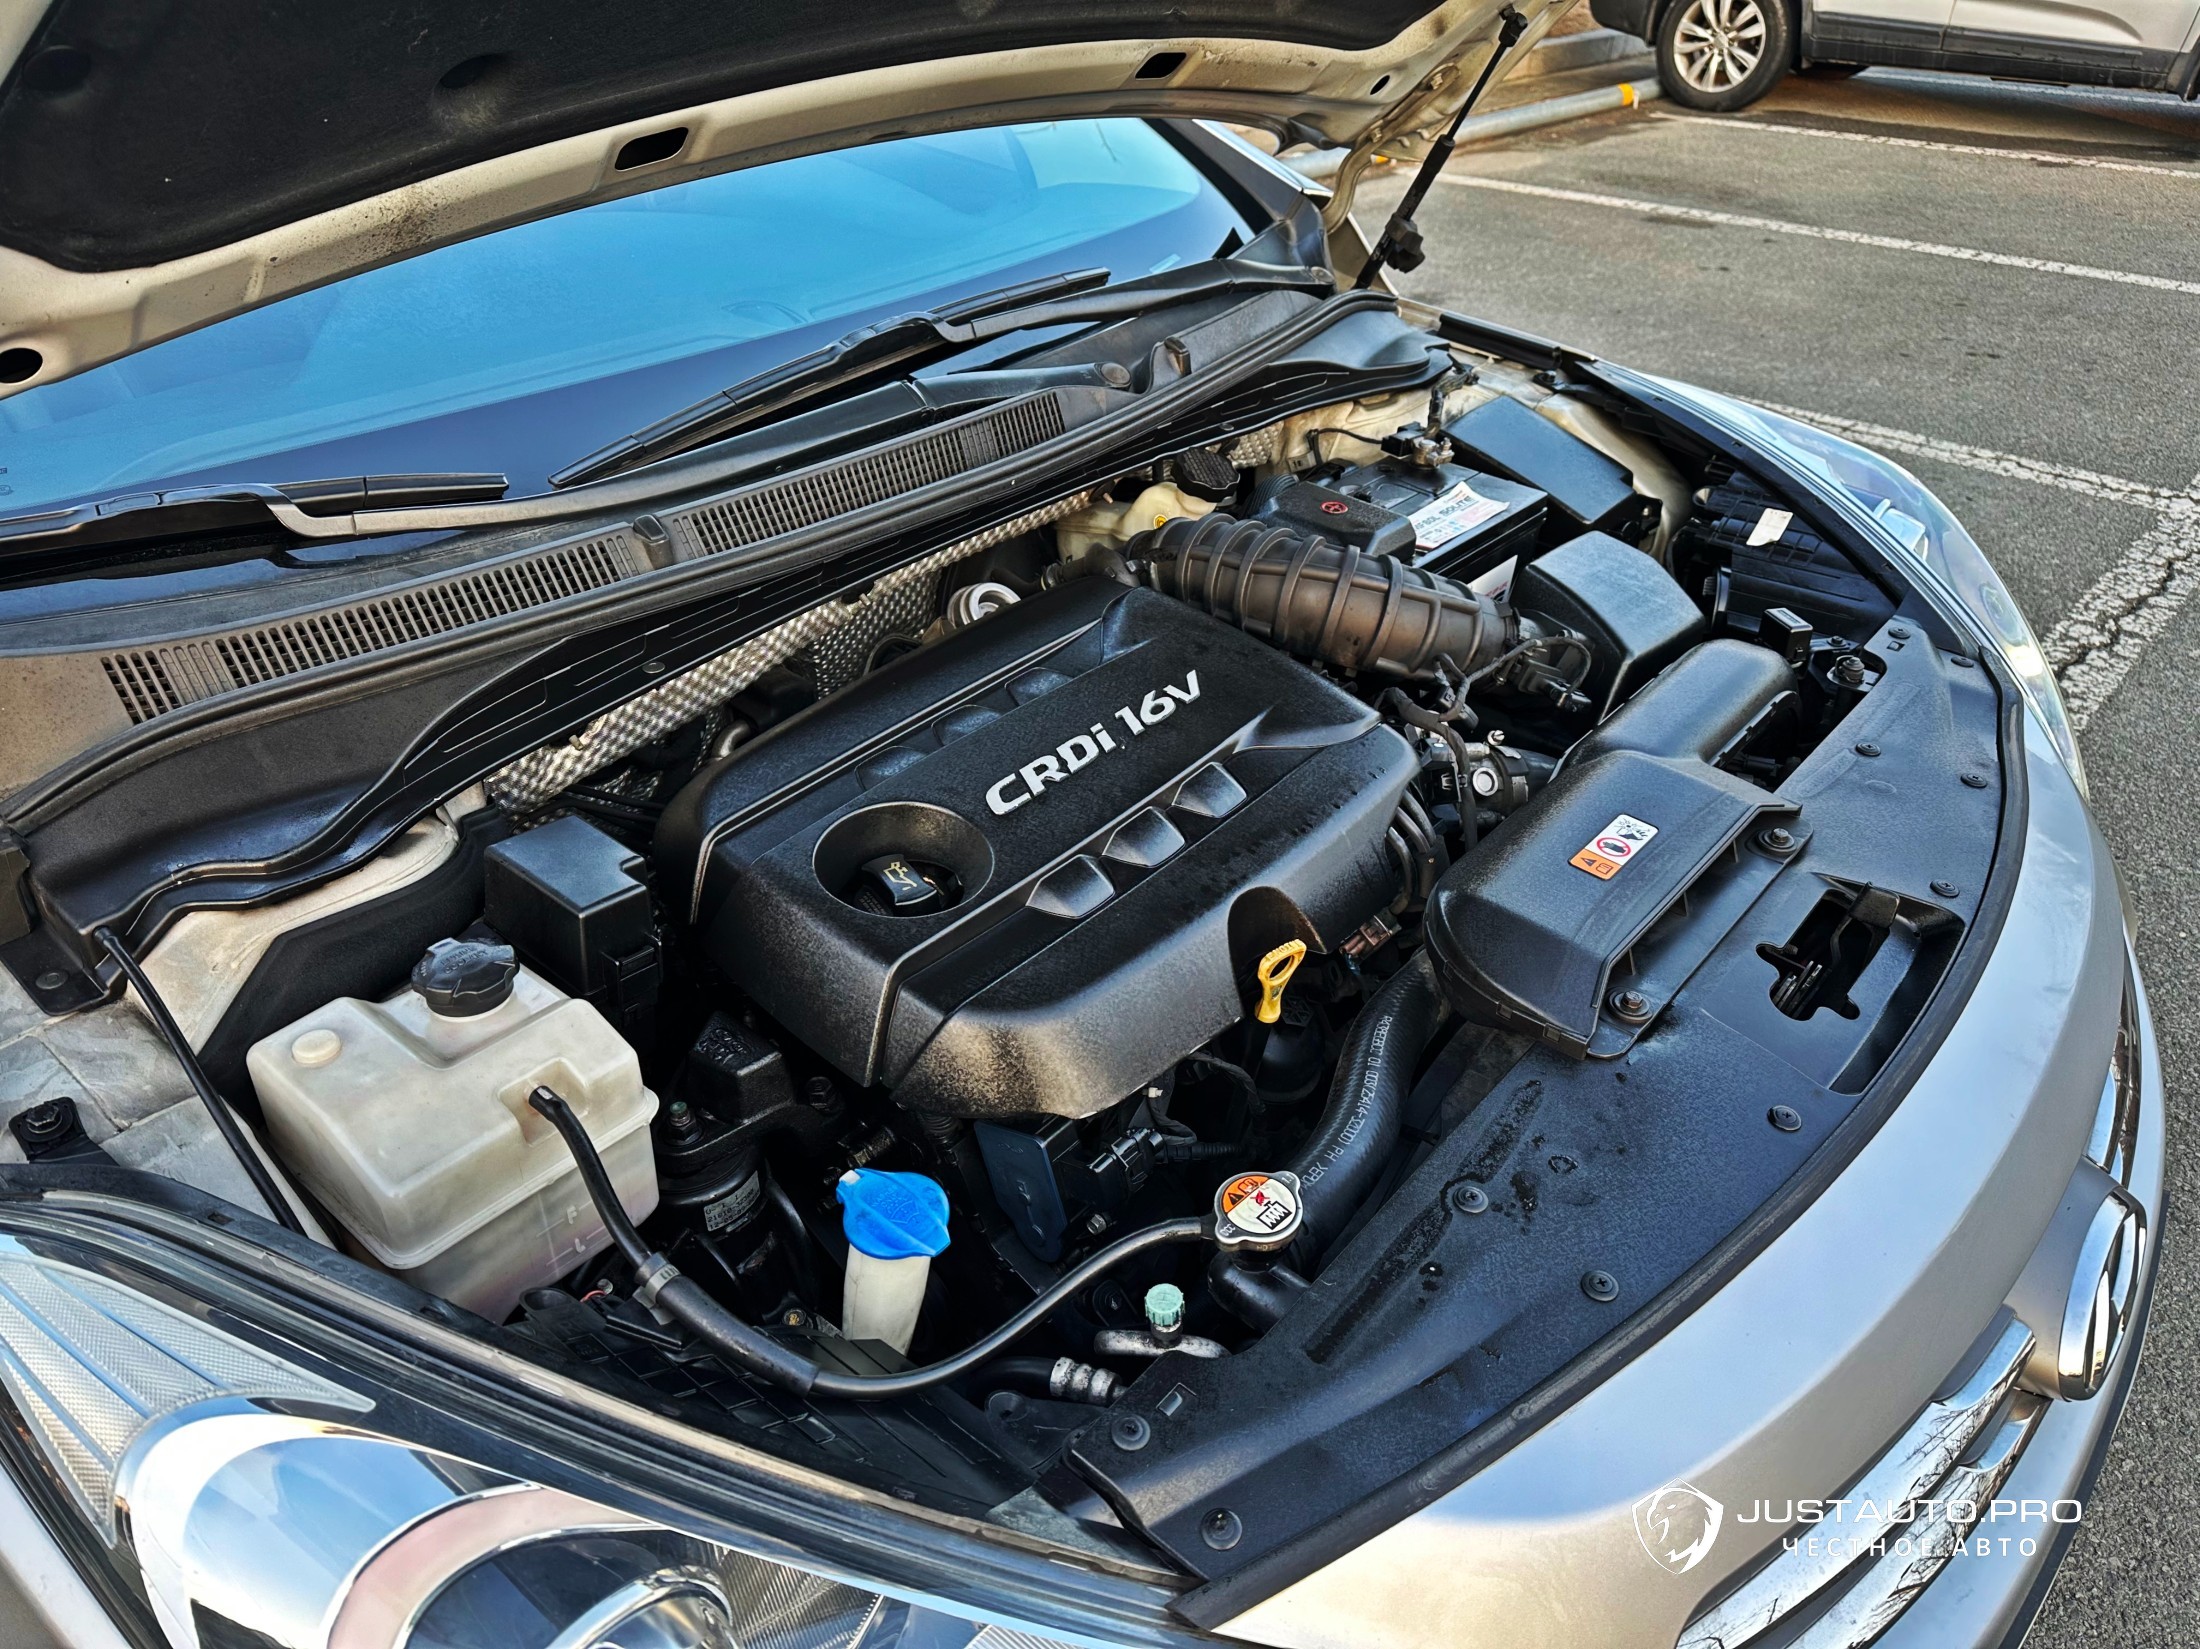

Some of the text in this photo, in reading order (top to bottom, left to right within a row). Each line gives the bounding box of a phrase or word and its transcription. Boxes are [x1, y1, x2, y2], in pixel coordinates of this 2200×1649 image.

[985, 669, 1201, 815] CRDi 16V
[1324, 1144, 1344, 1162] PH
[566, 1205, 578, 1225] F
